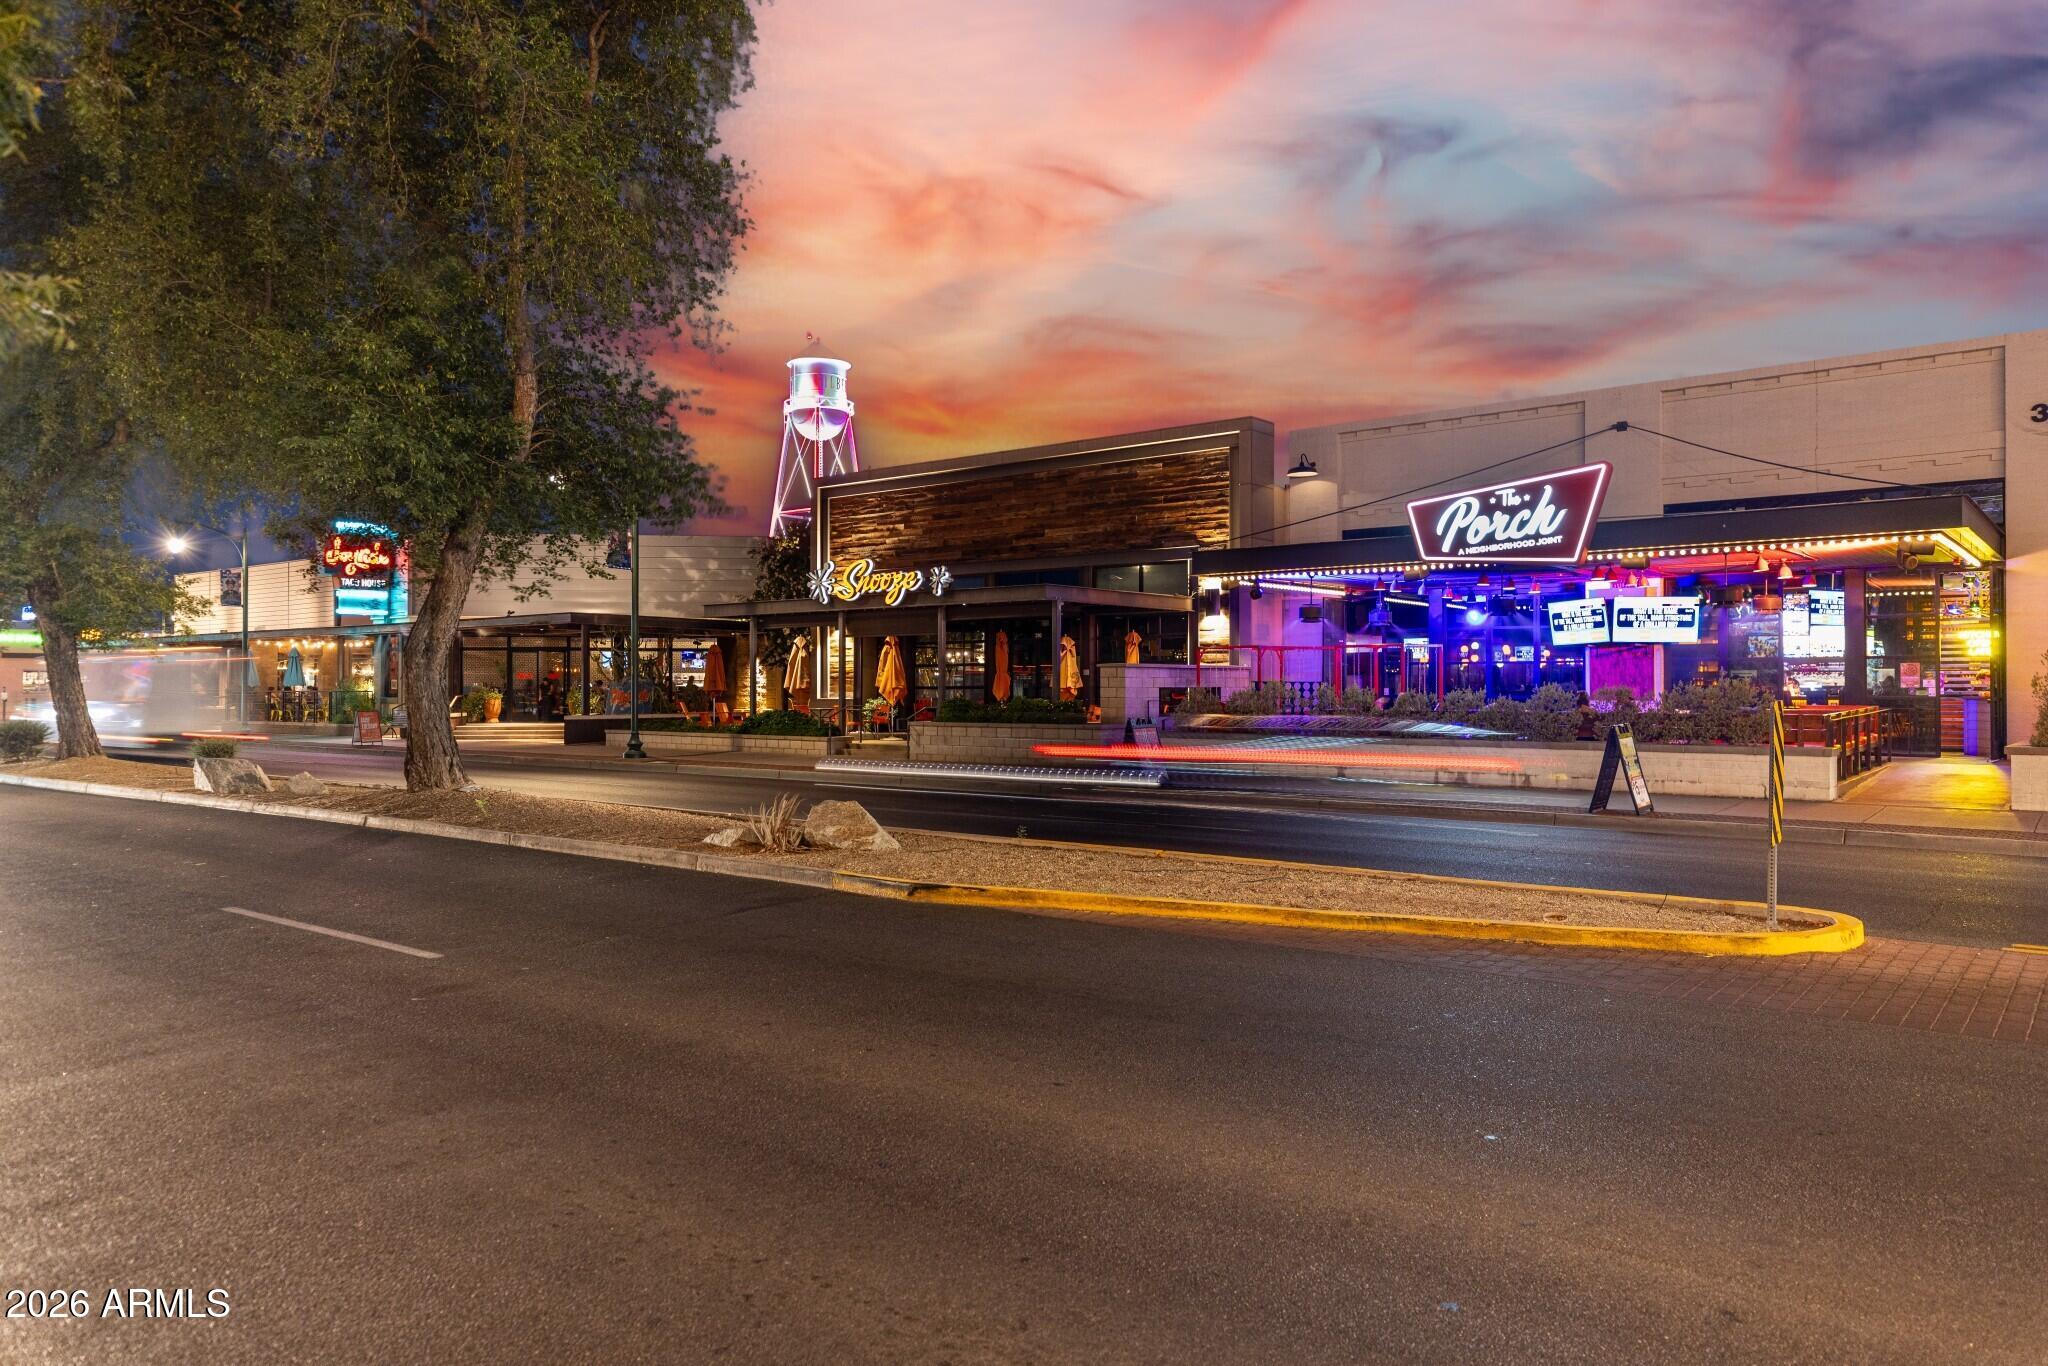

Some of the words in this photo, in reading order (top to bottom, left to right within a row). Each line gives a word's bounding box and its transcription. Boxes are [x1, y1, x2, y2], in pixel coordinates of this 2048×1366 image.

[1494, 488, 1522, 507] The
[1436, 484, 1568, 553] Porch
[1457, 547, 1465, 556] A
[1465, 539, 1535, 554] NEIGHBORHOOD
[1536, 535, 1563, 546] JOINT
[833, 559, 923, 606] Snooze
